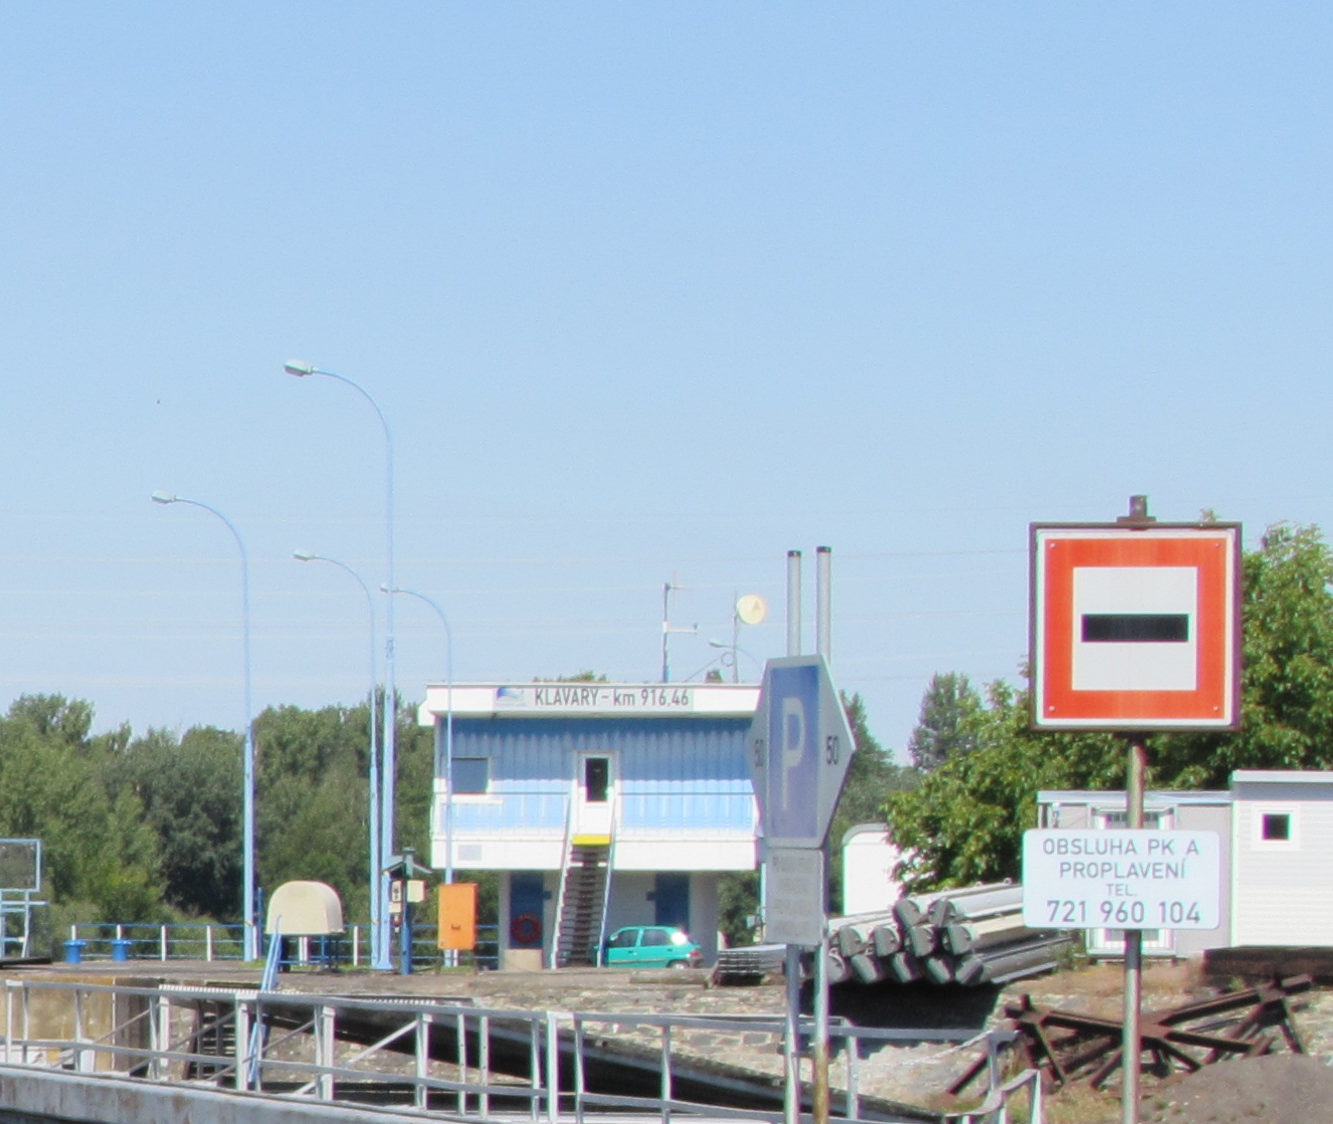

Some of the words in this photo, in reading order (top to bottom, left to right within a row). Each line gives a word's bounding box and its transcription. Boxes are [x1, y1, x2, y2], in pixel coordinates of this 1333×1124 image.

[534, 687, 598, 706] KLAVARY
[613, 687, 635, 706] km
[782, 697, 806, 811] P
[826, 735, 839, 766] 50
[1042, 838, 1137, 855] OBSLUHA
[1147, 838, 1175, 855] PK
[1185, 839, 1199, 855] A
[1059, 857, 1186, 879] PROPLAVENÍ
[1106, 883, 1138, 897] TEL.
[1046, 900, 1086, 922] 721
[1100, 900, 1145, 923] 960
[1159, 901, 1201, 924] 104
